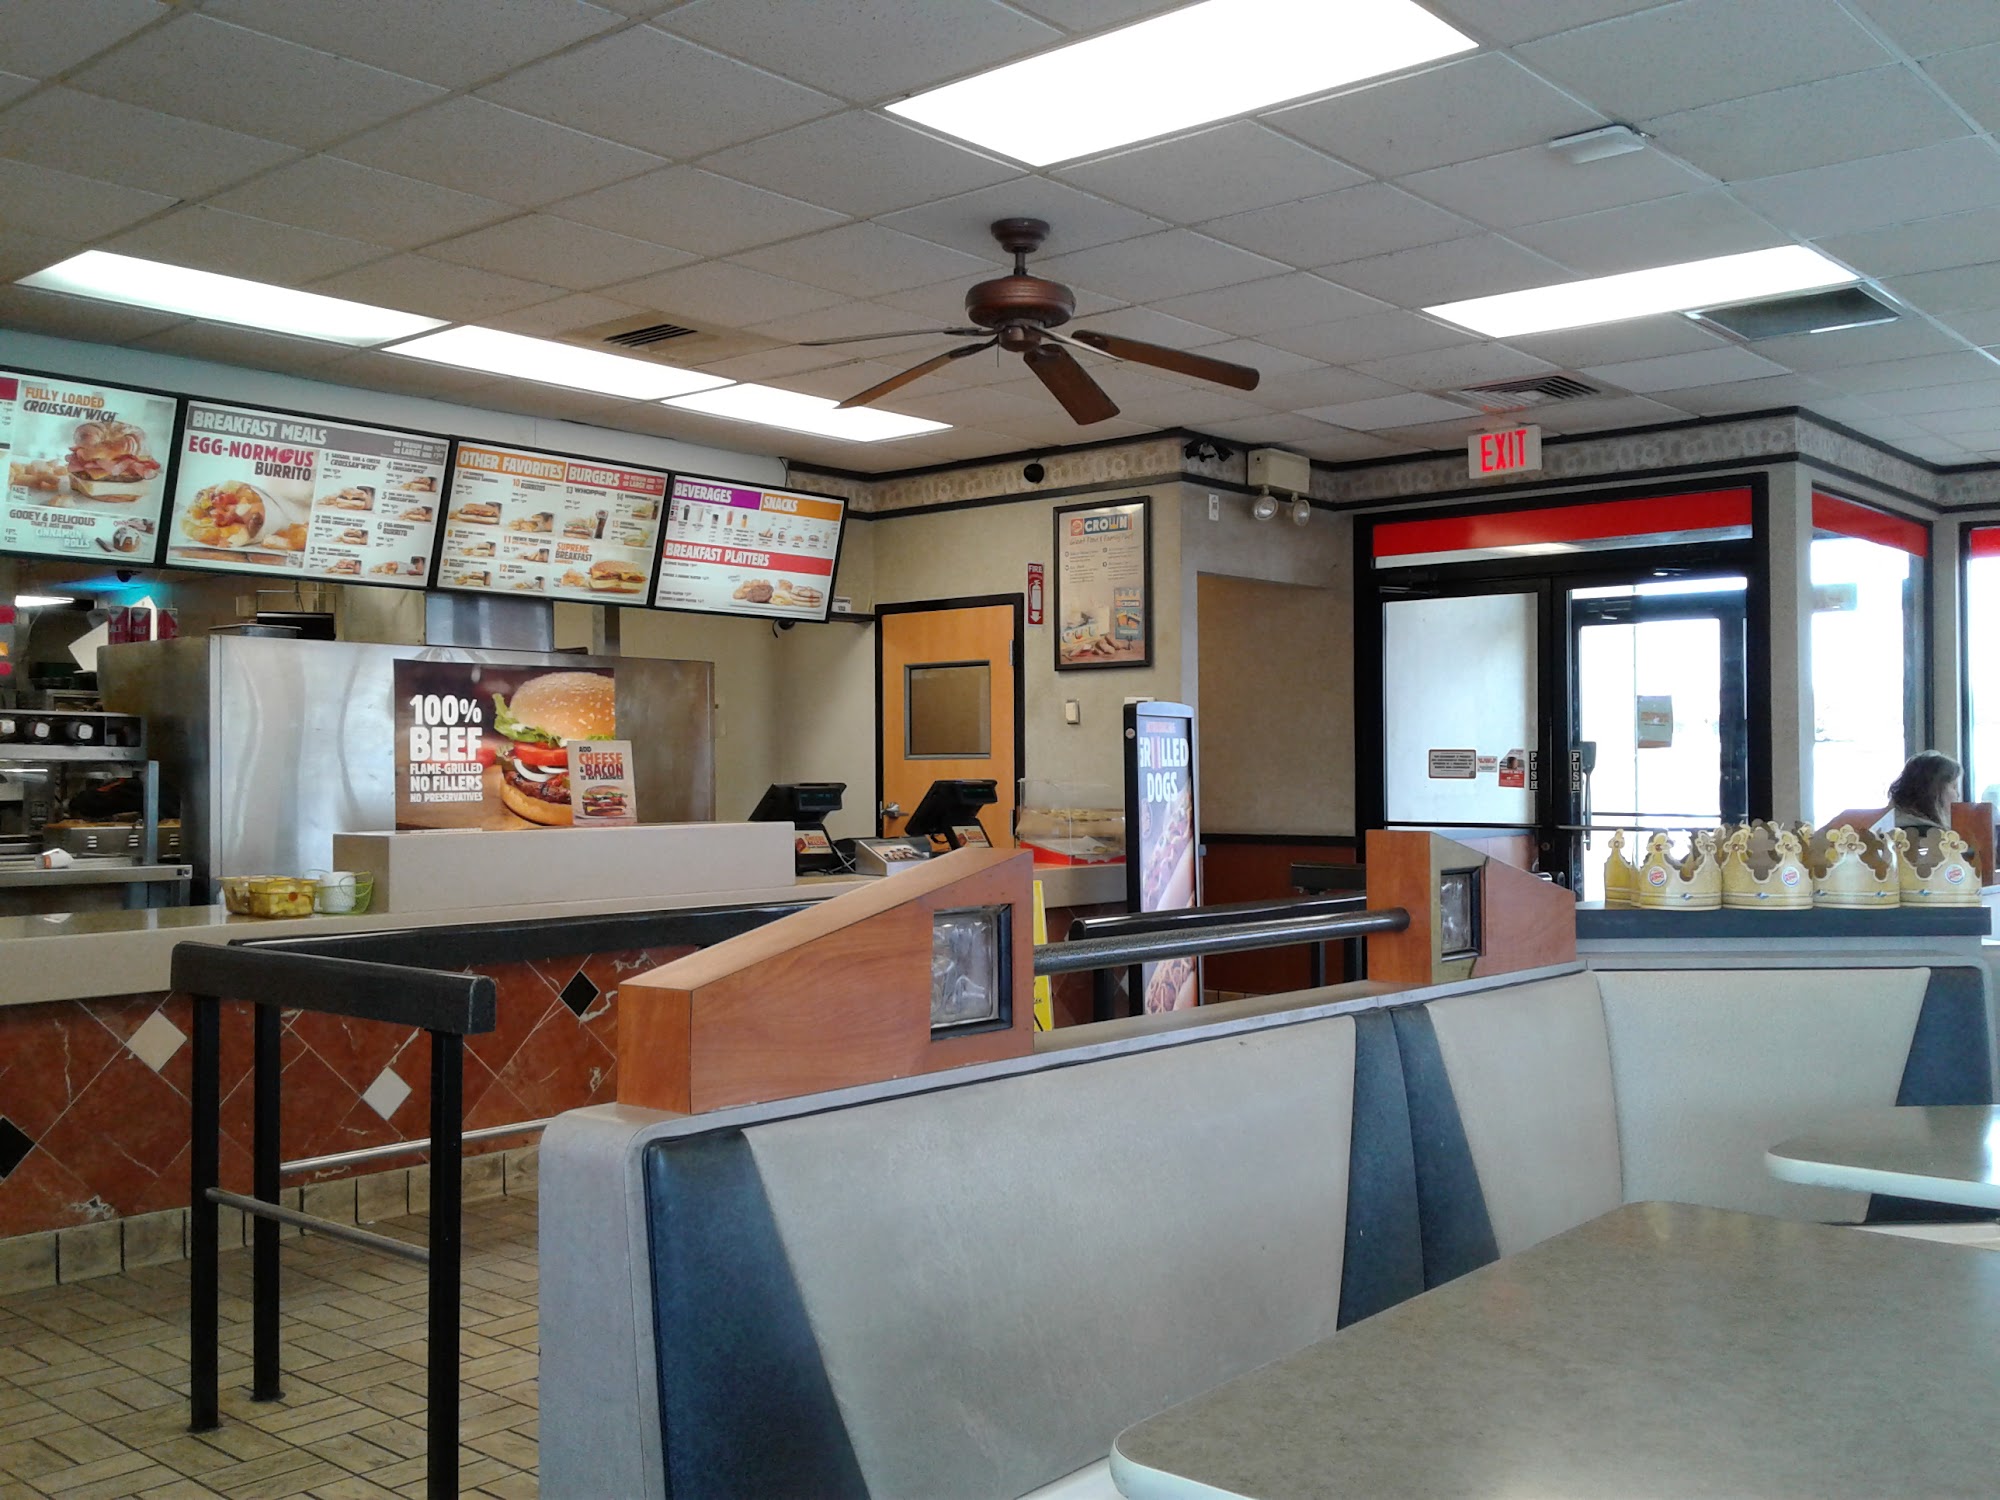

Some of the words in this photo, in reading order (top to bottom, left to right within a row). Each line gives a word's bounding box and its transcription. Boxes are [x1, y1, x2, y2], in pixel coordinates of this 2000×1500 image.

[25, 386, 59, 401] FULLY
[62, 392, 105, 409] LOADED
[191, 410, 278, 438] BREAKFAST
[280, 423, 327, 445] MEALS
[188, 434, 315, 468] EGG-NORMOUS
[401, 448, 421, 457] LARGE
[1480, 429, 1527, 472] EXIT
[254, 461, 311, 481] BURRITO
[460, 451, 500, 469] OTHER
[502, 457, 564, 479] FAVORITES
[568, 466, 620, 487] BURGERS
[674, 483, 732, 504] BEVERAGES
[763, 496, 799, 512] SNACKS
[9, 508, 41, 521] GOOEY
[42, 512, 49, 522] &
[51, 513, 96, 527] DELICIOUS
[377, 521, 383, 530] 6
[1084, 515, 1128, 532] CROWN
[63, 537, 91, 549] ROLLS
[557, 541, 590, 554] SUPREME
[555, 551, 593, 562] BREAKFAST
[665, 542, 722, 562] BREAKFAST
[723, 548, 770, 567] PLATTERS
[1028, 564, 1043, 573] FIRE
[409, 694, 482, 726] 100%
[409, 726, 483, 762] BEEF
[579, 752, 623, 765] CHEESE
[409, 763, 483, 775] FLAME-GRILLED
[585, 763, 624, 777] BACON
[1530, 752, 1538, 790] PUSH
[1572, 752, 1581, 791] PUSH
[410, 776, 430, 792] NO
[432, 775, 483, 792] FILLERS
[1147, 771, 1178, 803] DOGS
[409, 792, 422, 803] NO
[424, 791, 483, 803] PRESERVATIVES
